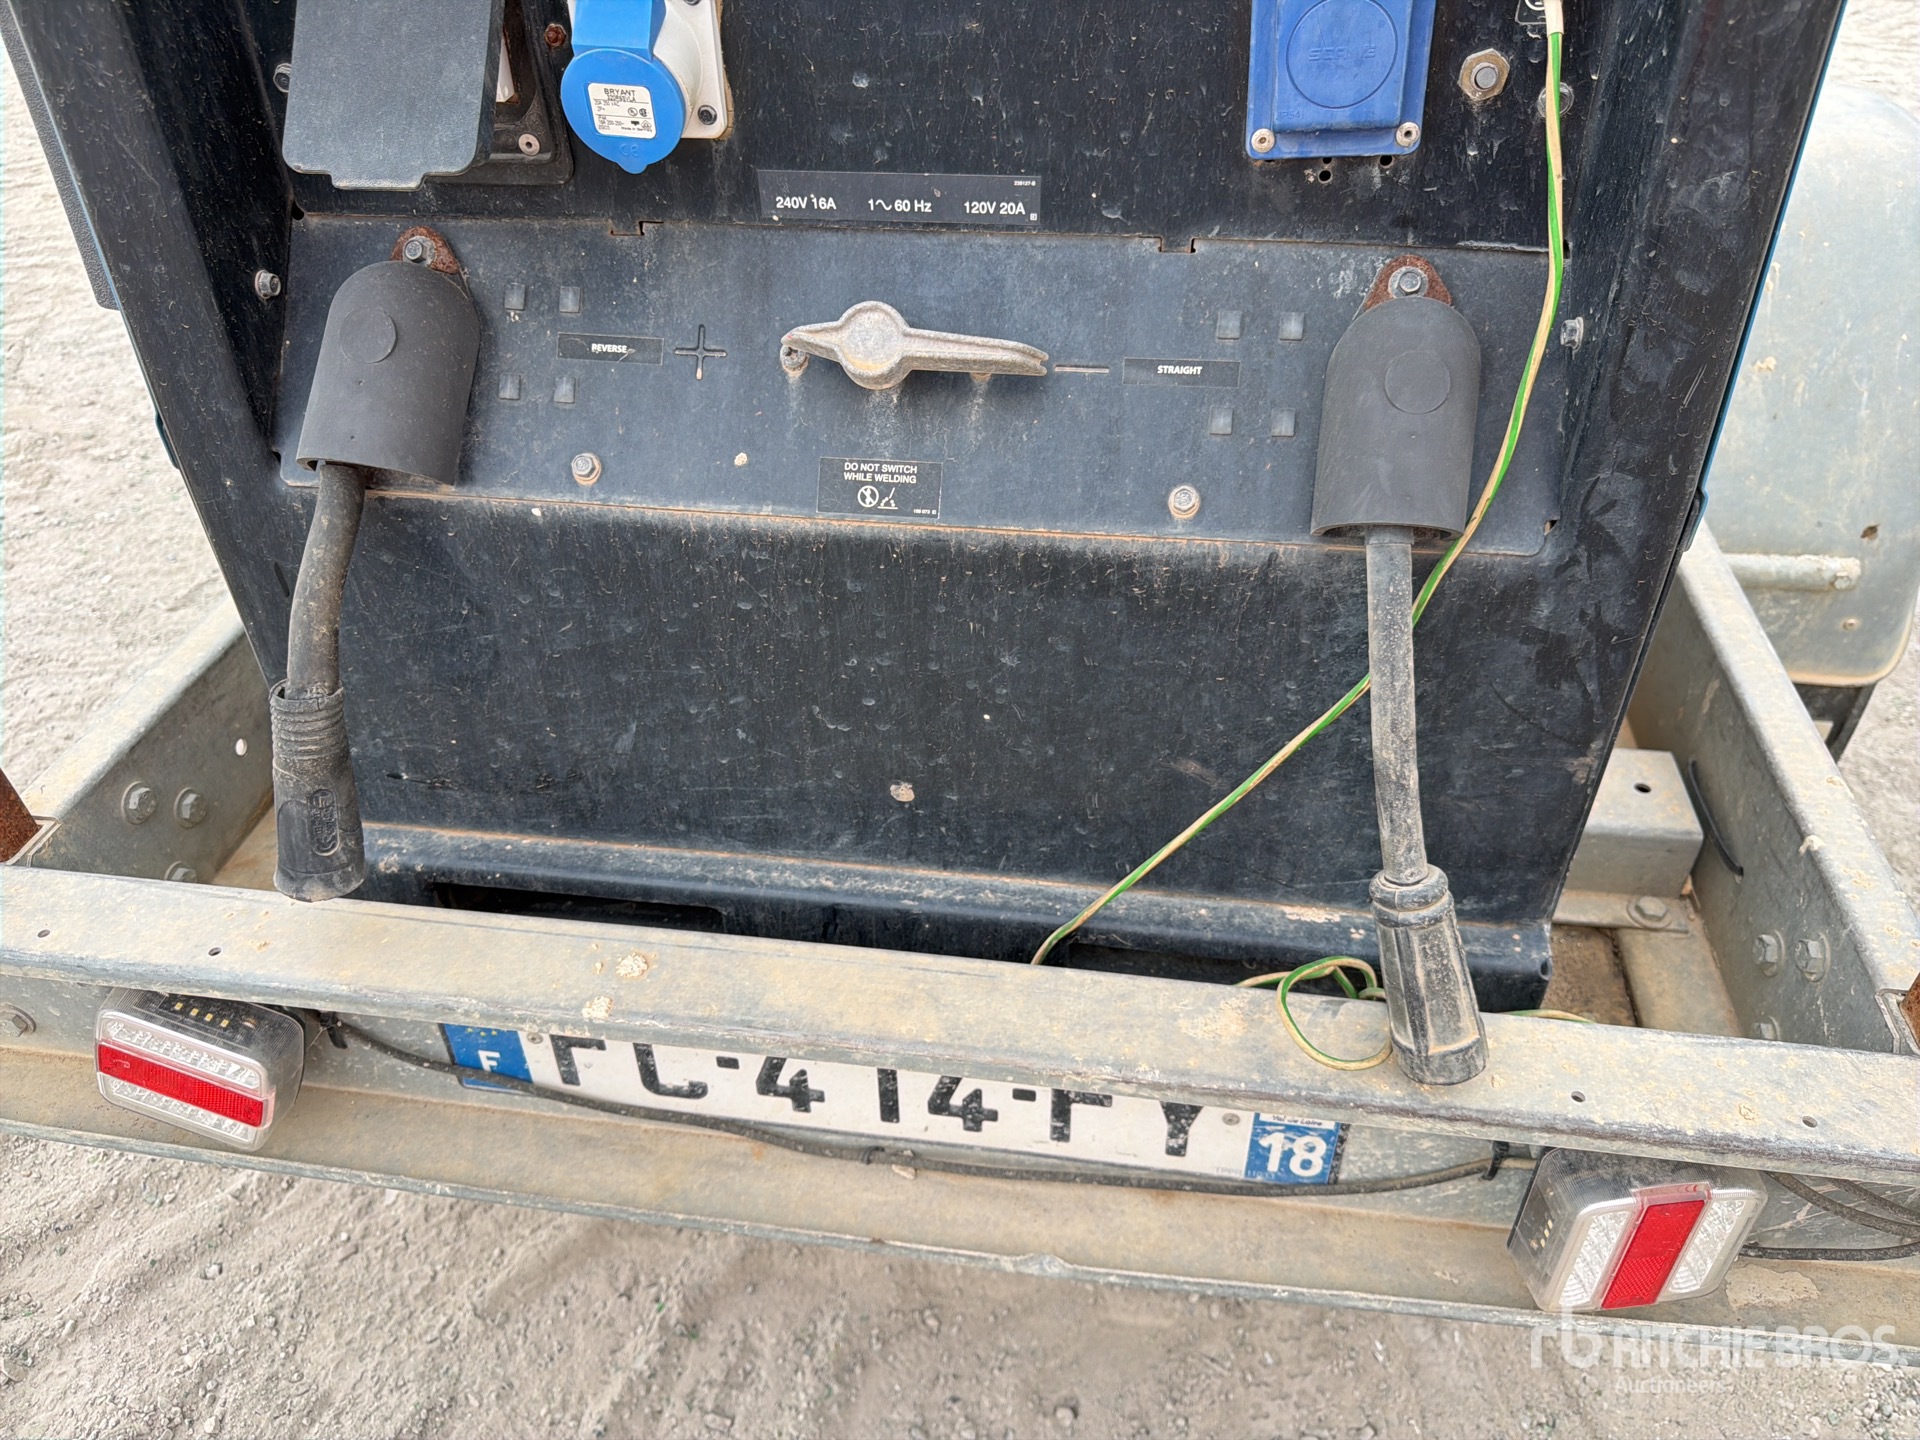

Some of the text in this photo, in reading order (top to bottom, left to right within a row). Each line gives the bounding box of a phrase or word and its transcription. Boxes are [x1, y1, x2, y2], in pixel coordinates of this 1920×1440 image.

[604, 88, 635, 96] BRYANT
[776, 196, 807, 210] 240V
[811, 196, 837, 210] 16A
[894, 199, 911, 212] 60
[914, 199, 932, 213] Hz
[963, 201, 997, 214] 120V
[1000, 202, 1026, 215] 20A
[591, 343, 628, 354] REVERSE
[1157, 364, 1203, 375] STRAIGHT
[844, 462, 918, 474] DO NOT SWITCH
[843, 472, 917, 484] WHILE WELDING
[477, 1049, 501, 1072] F
[1258, 1132, 1327, 1177] 18
